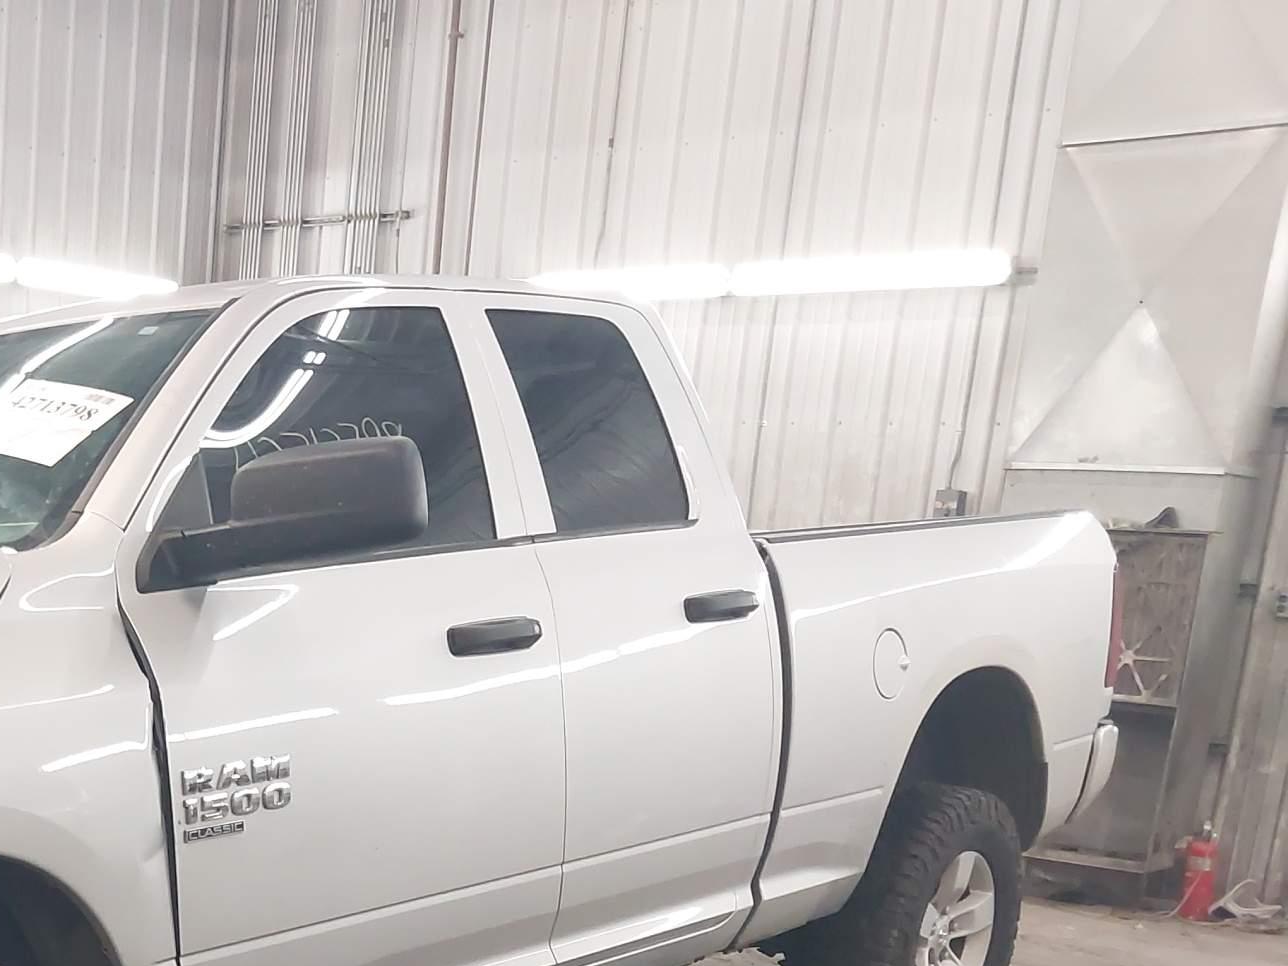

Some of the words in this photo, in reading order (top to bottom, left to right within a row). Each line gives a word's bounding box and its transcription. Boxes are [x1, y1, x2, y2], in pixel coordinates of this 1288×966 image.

[11, 396, 100, 422] 42713798
[181, 754, 291, 795] RAM
[183, 782, 291, 825] 1500
[187, 821, 244, 841] CLASSIC
